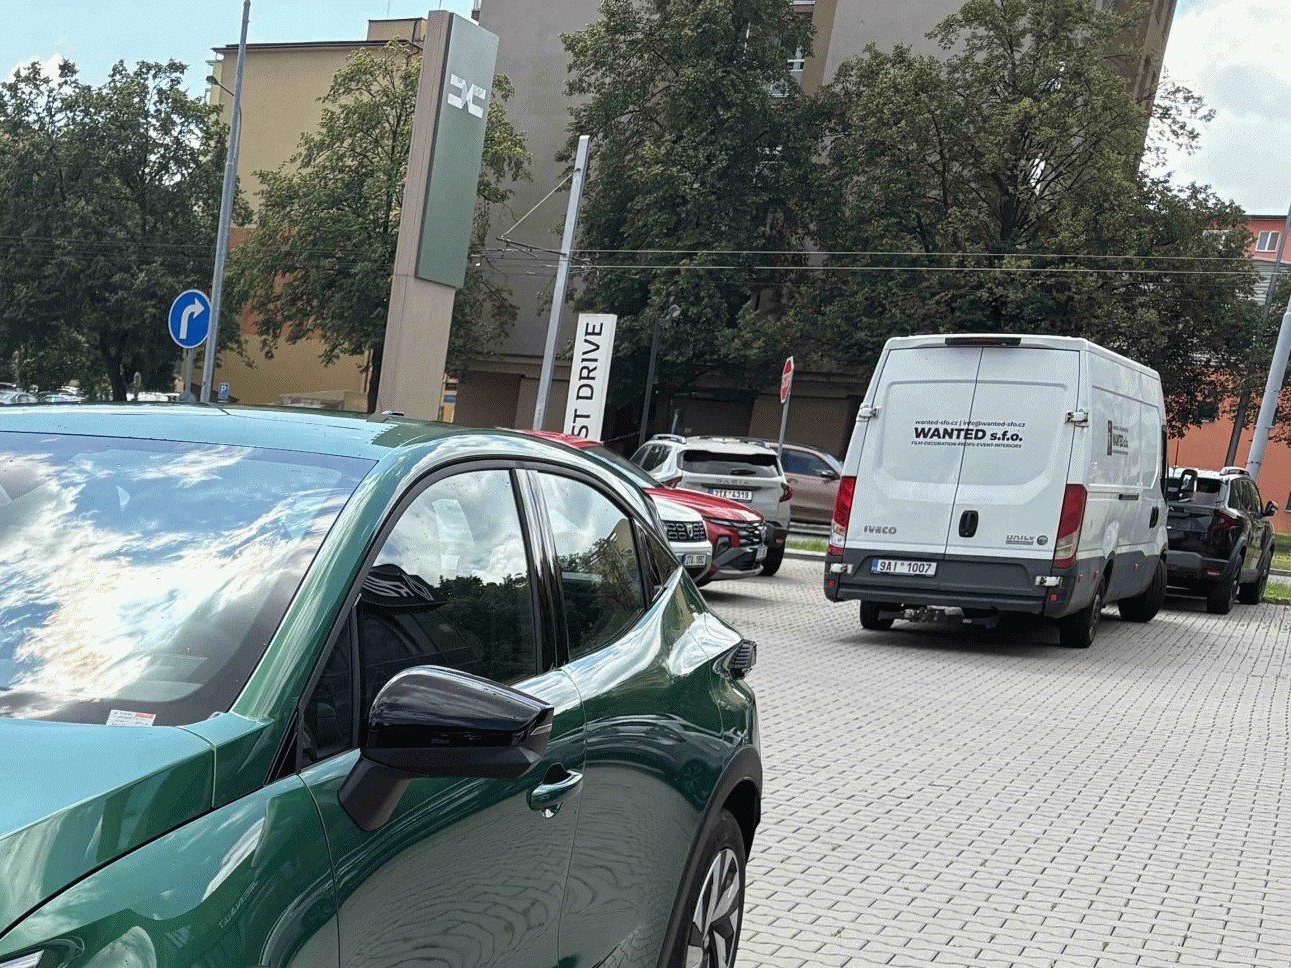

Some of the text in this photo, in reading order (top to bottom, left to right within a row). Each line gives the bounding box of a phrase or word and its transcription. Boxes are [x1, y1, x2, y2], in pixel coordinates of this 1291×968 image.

[576, 322, 604, 401] DRIVE
[914, 427, 1023, 442] WANTED s.f.o.
[880, 561, 932, 574] 9AI 1007
